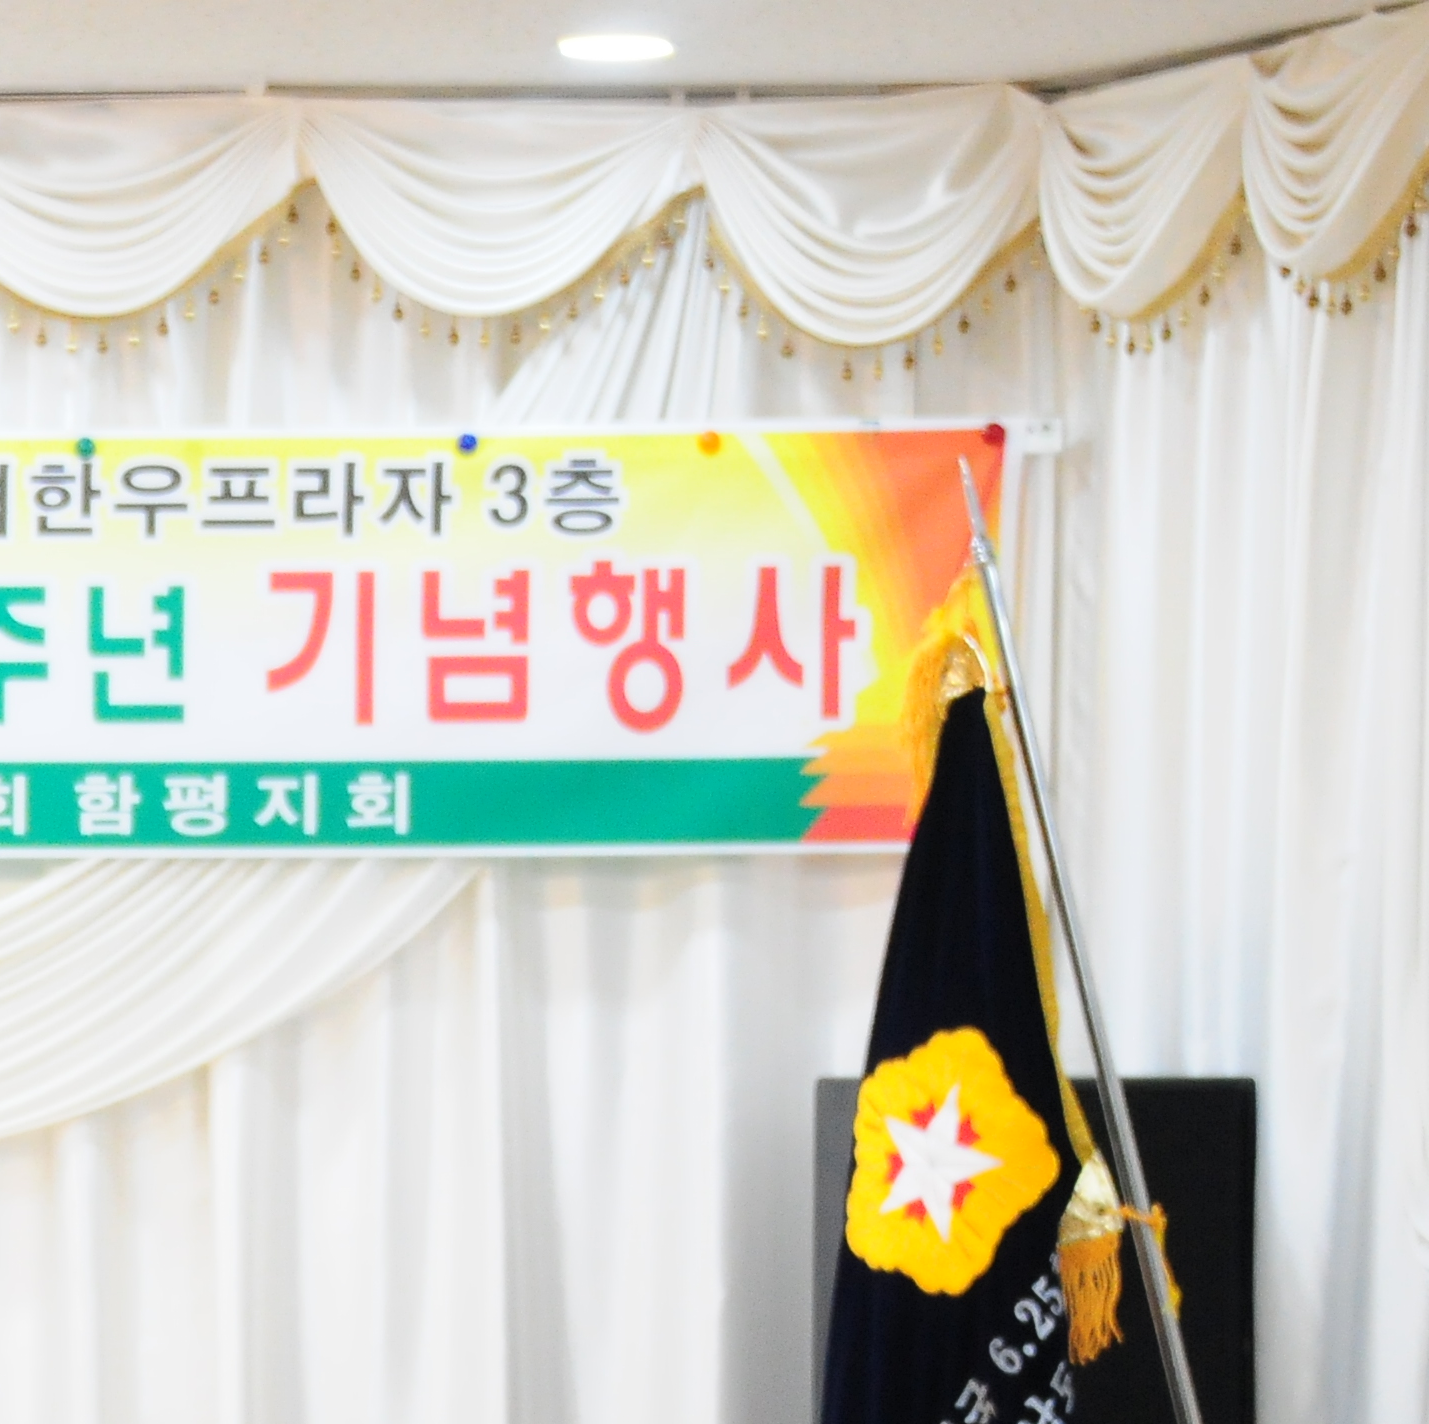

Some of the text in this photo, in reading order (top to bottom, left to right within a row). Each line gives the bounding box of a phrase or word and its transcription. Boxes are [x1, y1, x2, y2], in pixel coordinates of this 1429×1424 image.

[492, 460, 618, 532] 3층
[267, 561, 856, 733] 기념행사
[75, 773, 409, 836] 함평지회
[989, 1252, 1063, 1374] 6.25
